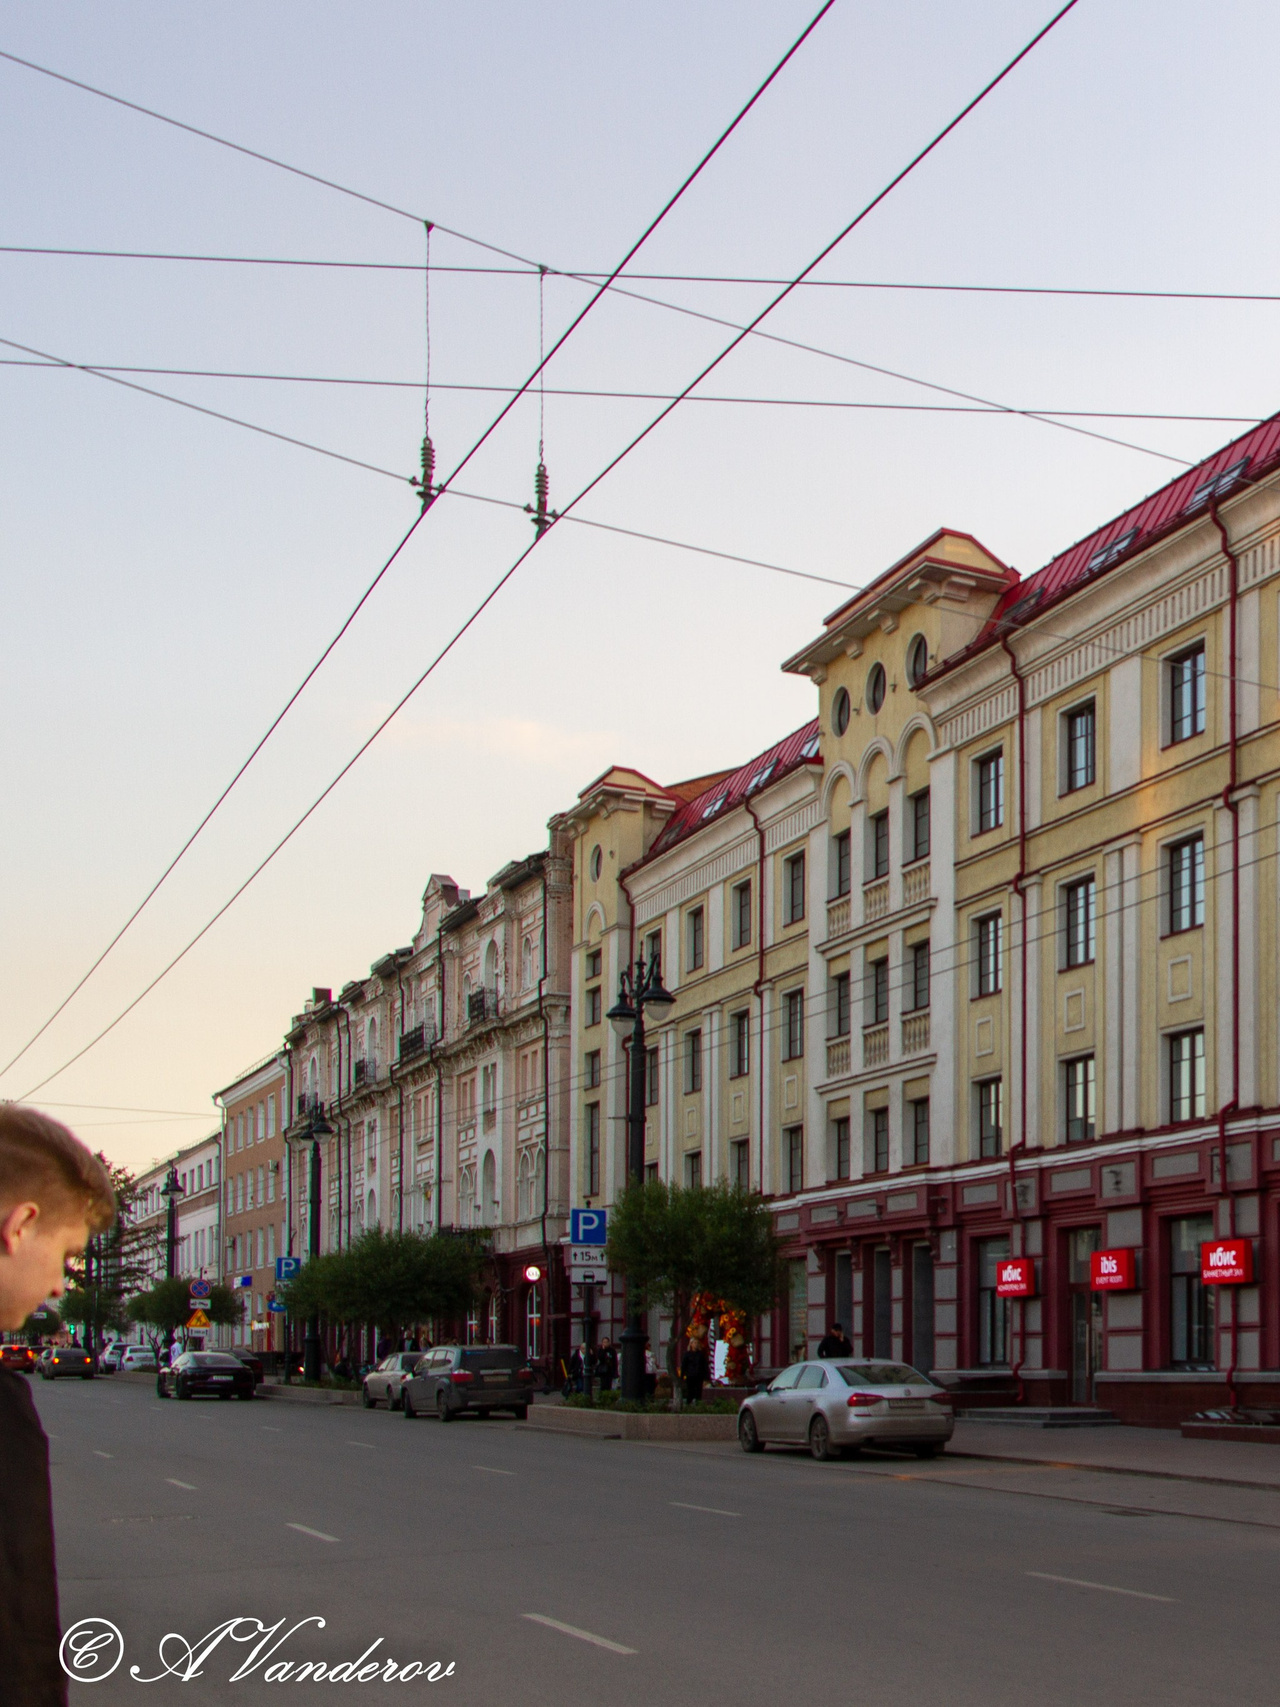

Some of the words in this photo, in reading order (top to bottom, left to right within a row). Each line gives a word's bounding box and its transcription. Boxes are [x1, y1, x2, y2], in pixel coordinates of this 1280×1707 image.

[578, 1212, 599, 1241] P
[1101, 1255, 1117, 1273] ibis
[1209, 1246, 1236, 1266] ибис
[281, 1259, 295, 1277] P
[1002, 1264, 1021, 1281] ибис
